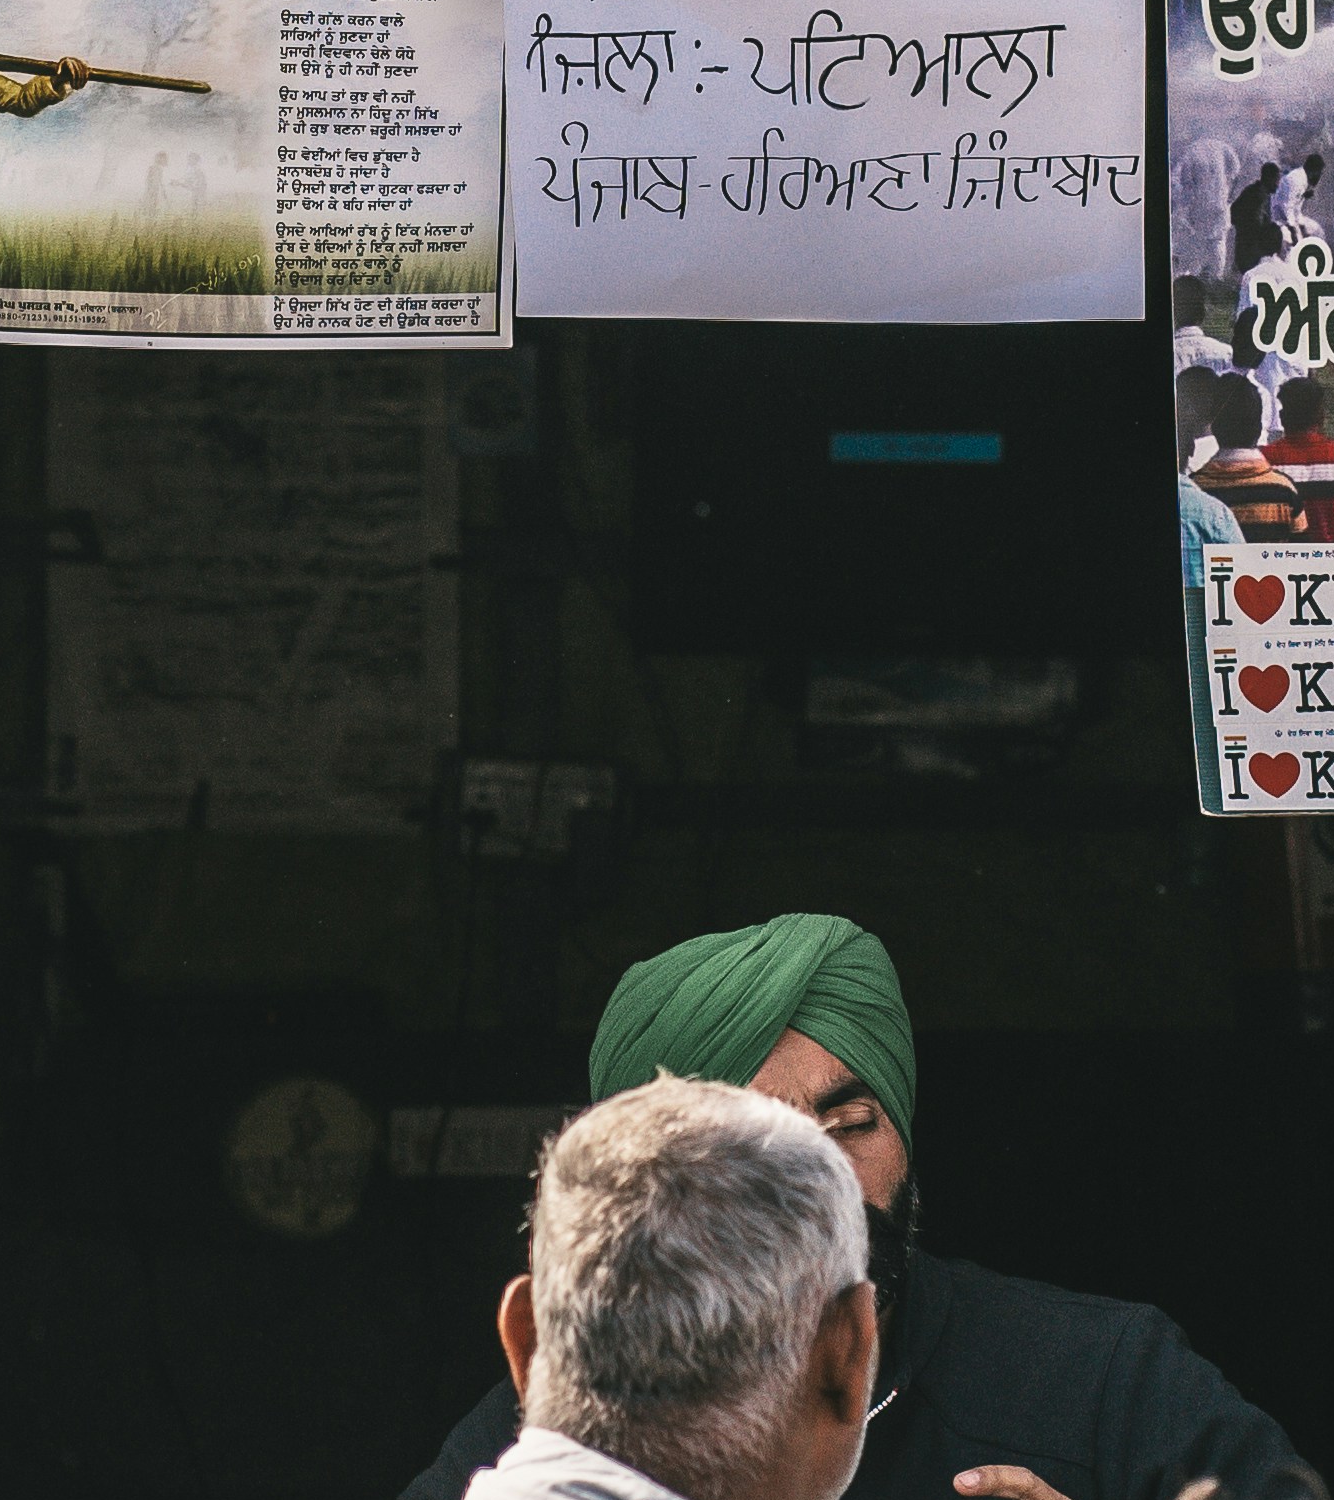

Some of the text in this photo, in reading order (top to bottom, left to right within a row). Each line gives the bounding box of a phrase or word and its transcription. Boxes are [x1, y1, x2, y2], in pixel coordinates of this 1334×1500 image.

[744, 9, 1067, 117] ਪਟਿਆਲਾ
[1210, 574, 1233, 626] I
[1215, 664, 1239, 717] I
[1224, 751, 1250, 800] I
